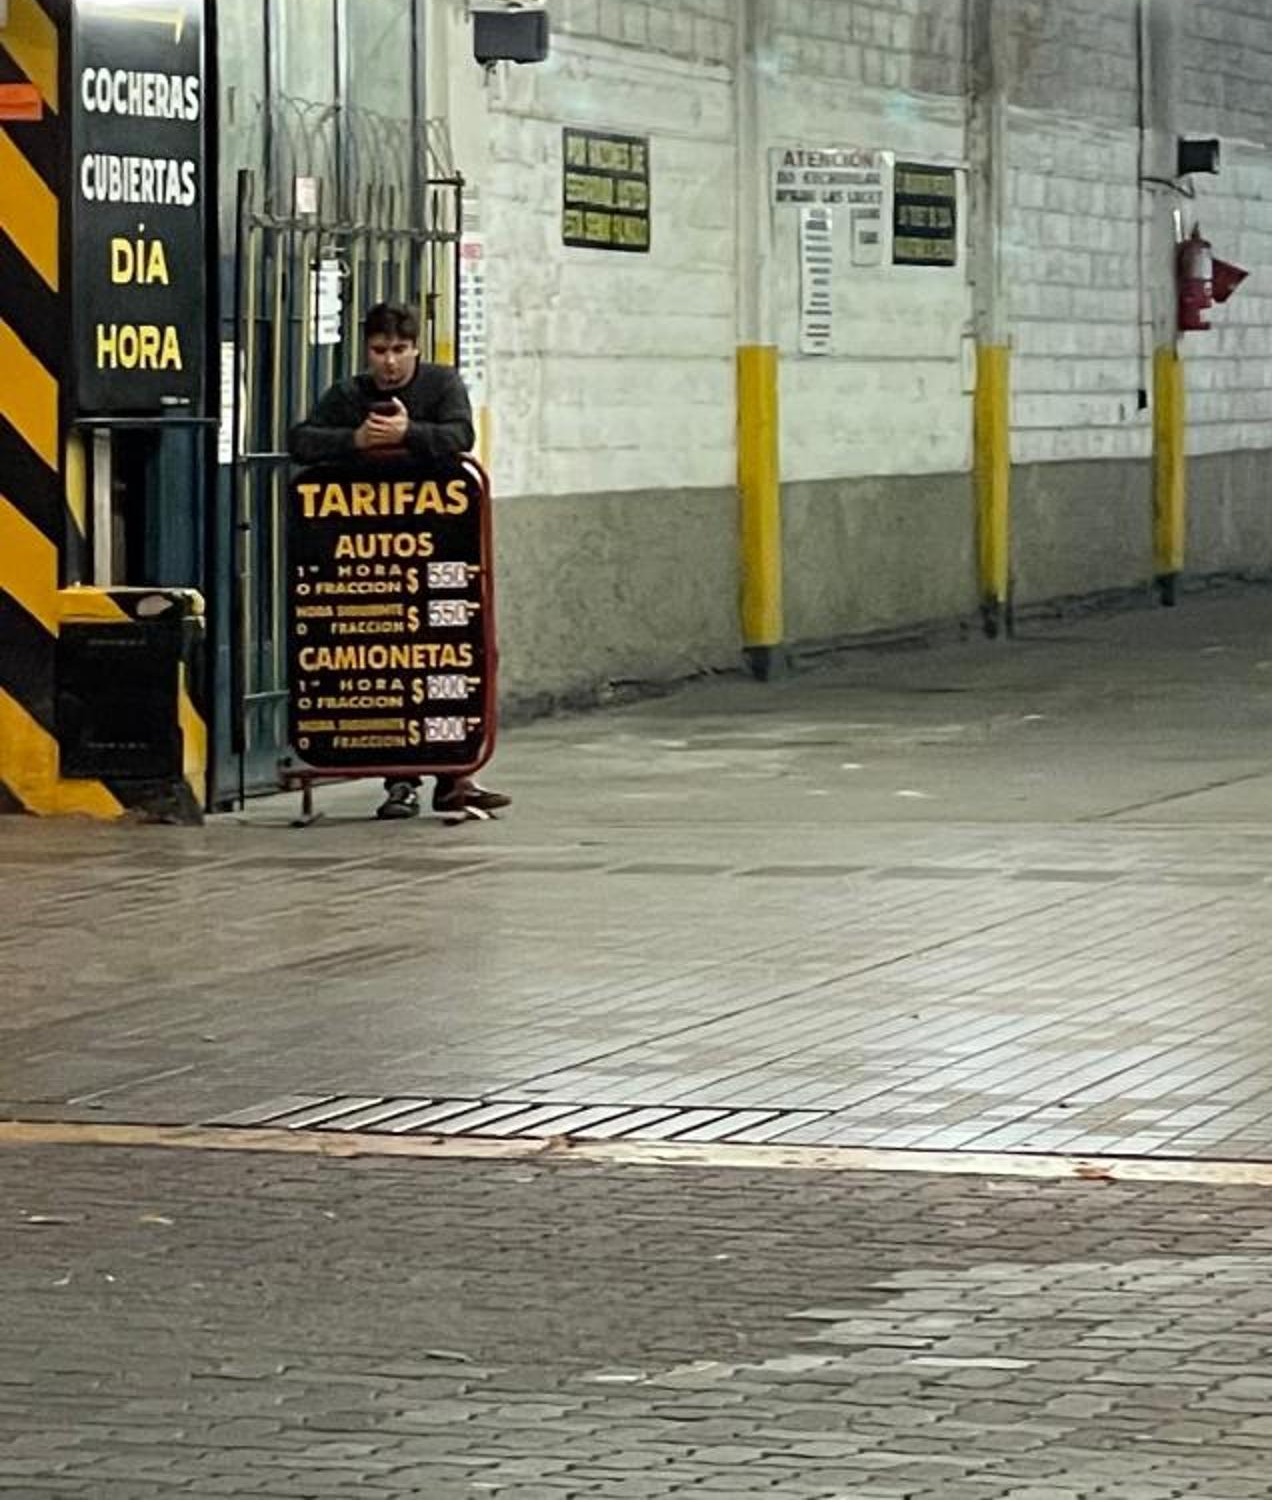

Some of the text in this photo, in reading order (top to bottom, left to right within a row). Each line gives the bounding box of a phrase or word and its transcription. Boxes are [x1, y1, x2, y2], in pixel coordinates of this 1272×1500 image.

[81, 67, 199, 121] COCHERAS
[81, 153, 196, 206] CUBIERTAS
[96, 323, 183, 370] HORA
[297, 479, 469, 518] TARIFAS
[334, 532, 434, 559] AUTOS
[337, 563, 403, 577] HORA
[299, 643, 473, 672] CAMIONETAS
[339, 677, 405, 691] HORA
